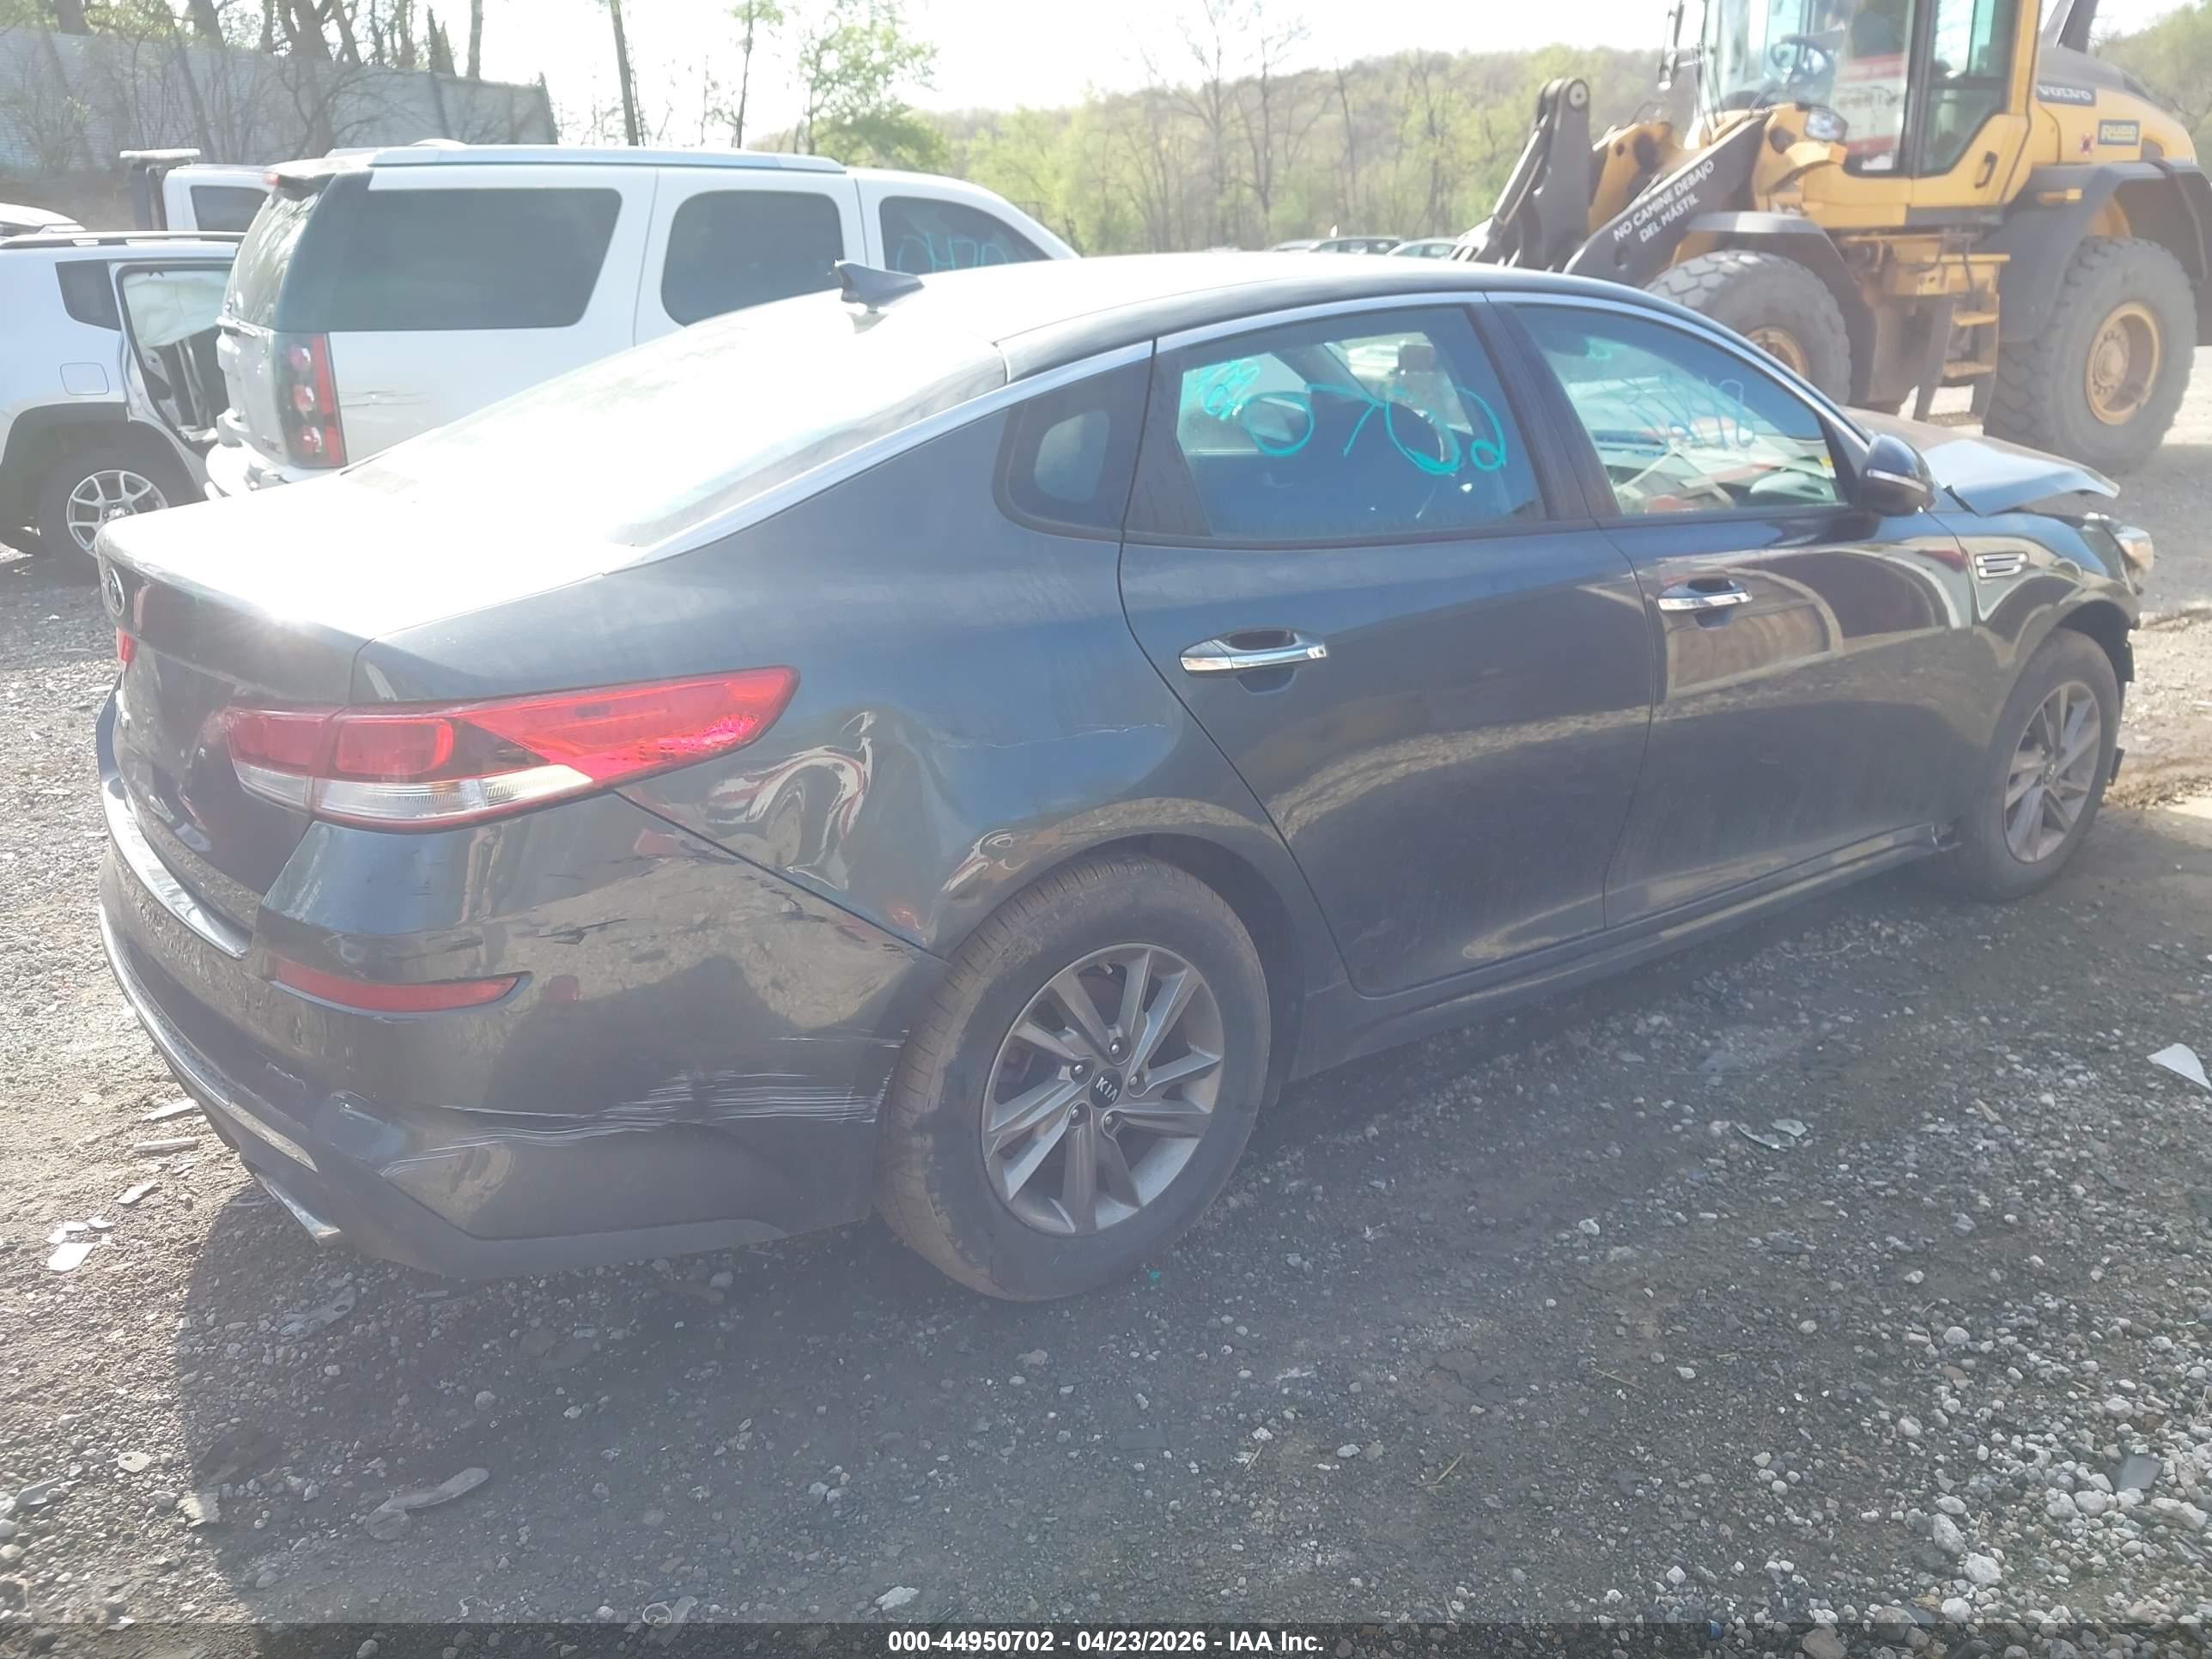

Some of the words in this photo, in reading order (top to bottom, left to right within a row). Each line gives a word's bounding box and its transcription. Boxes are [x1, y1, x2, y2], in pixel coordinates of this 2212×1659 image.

[2039, 85, 2092, 100] VOLVO
[1613, 221, 1632, 241] NO
[1633, 188, 1674, 226] CAMINE
[1674, 159, 1715, 196] DEBAJO
[1639, 221, 1662, 242] DEL
[1095, 1076, 1118, 1102] KIA
